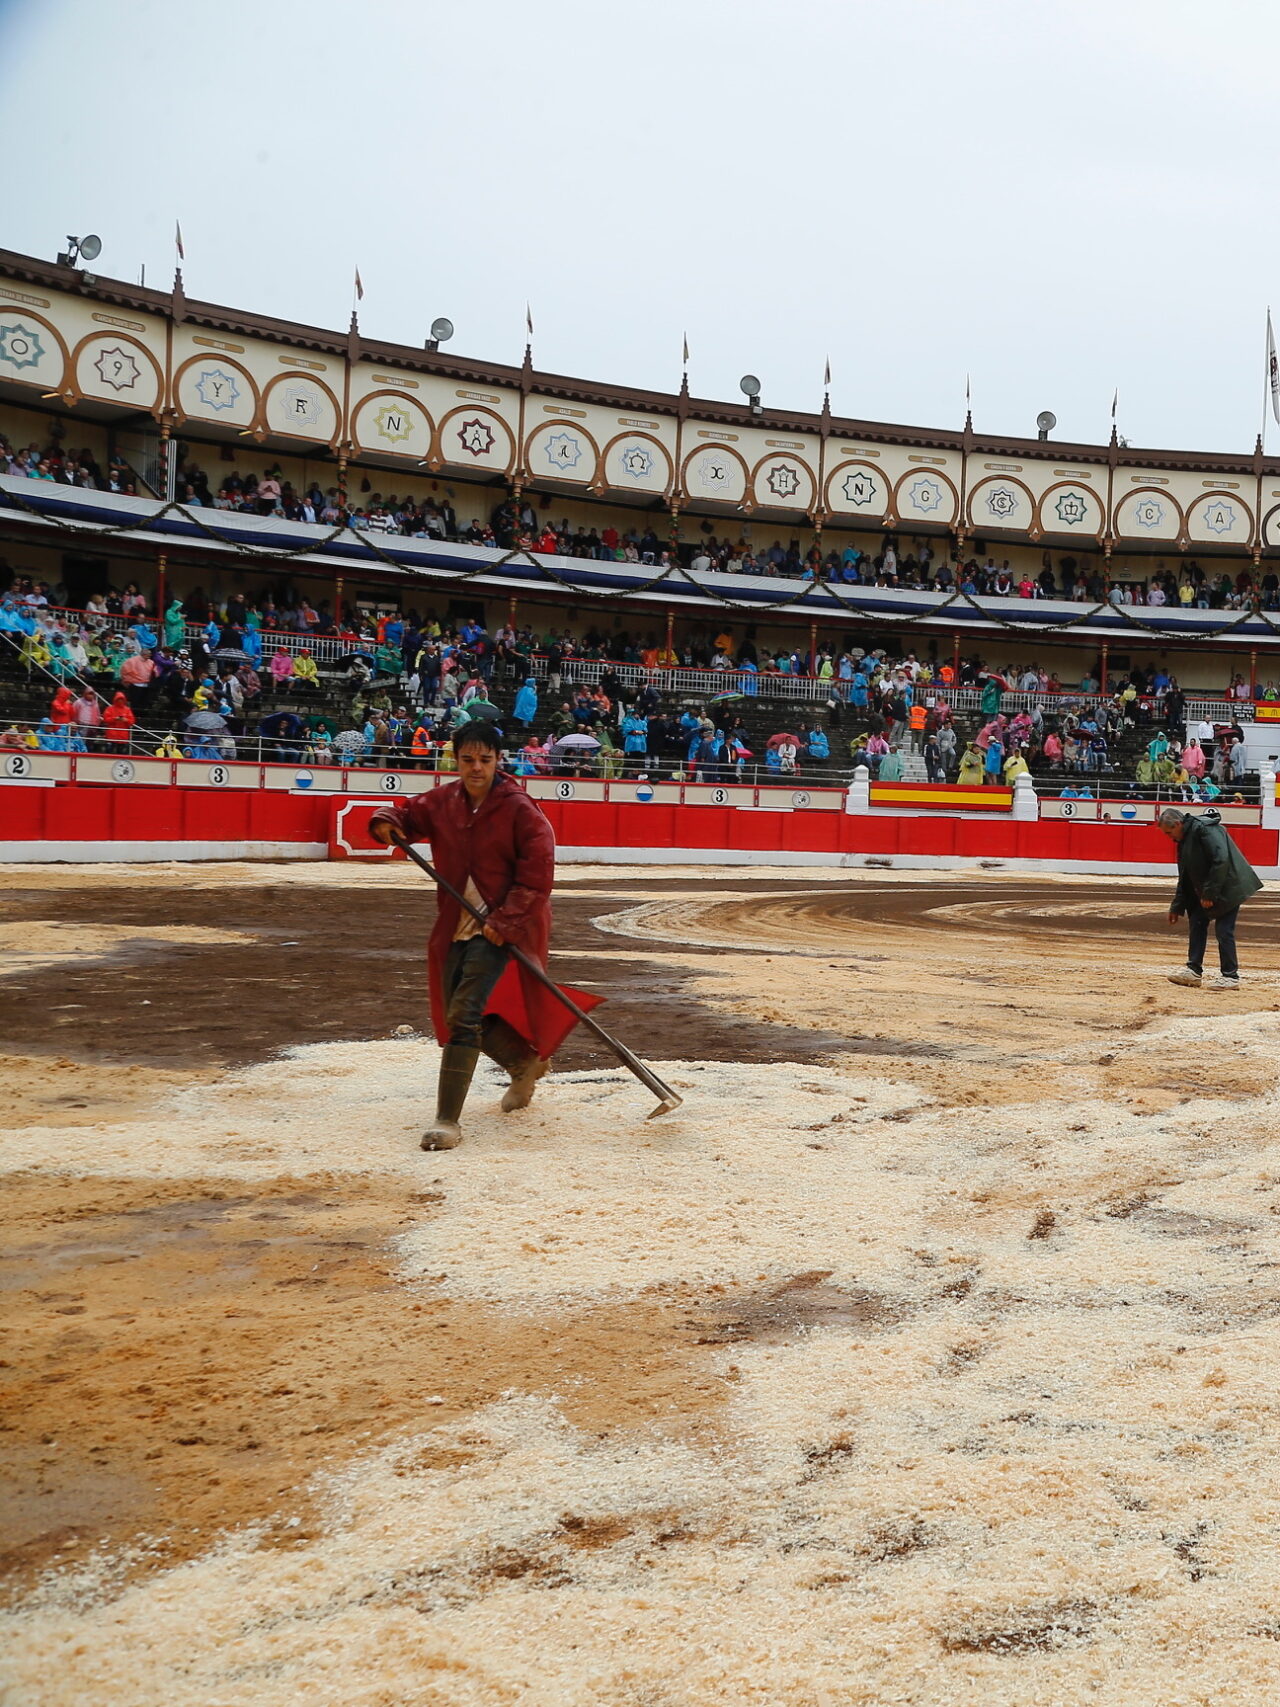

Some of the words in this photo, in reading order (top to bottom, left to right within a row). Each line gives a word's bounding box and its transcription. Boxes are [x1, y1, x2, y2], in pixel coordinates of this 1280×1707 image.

[387, 416, 400, 431] N
[854, 483, 864, 496] N
[1215, 511, 1224, 524] A
[13, 757, 23, 774] 2
[214, 768, 223, 783] 3
[386, 776, 395, 790] 3
[561, 783, 569, 796] 3
[715, 789, 723, 802] 3
[1064, 803, 1072, 815] 3
